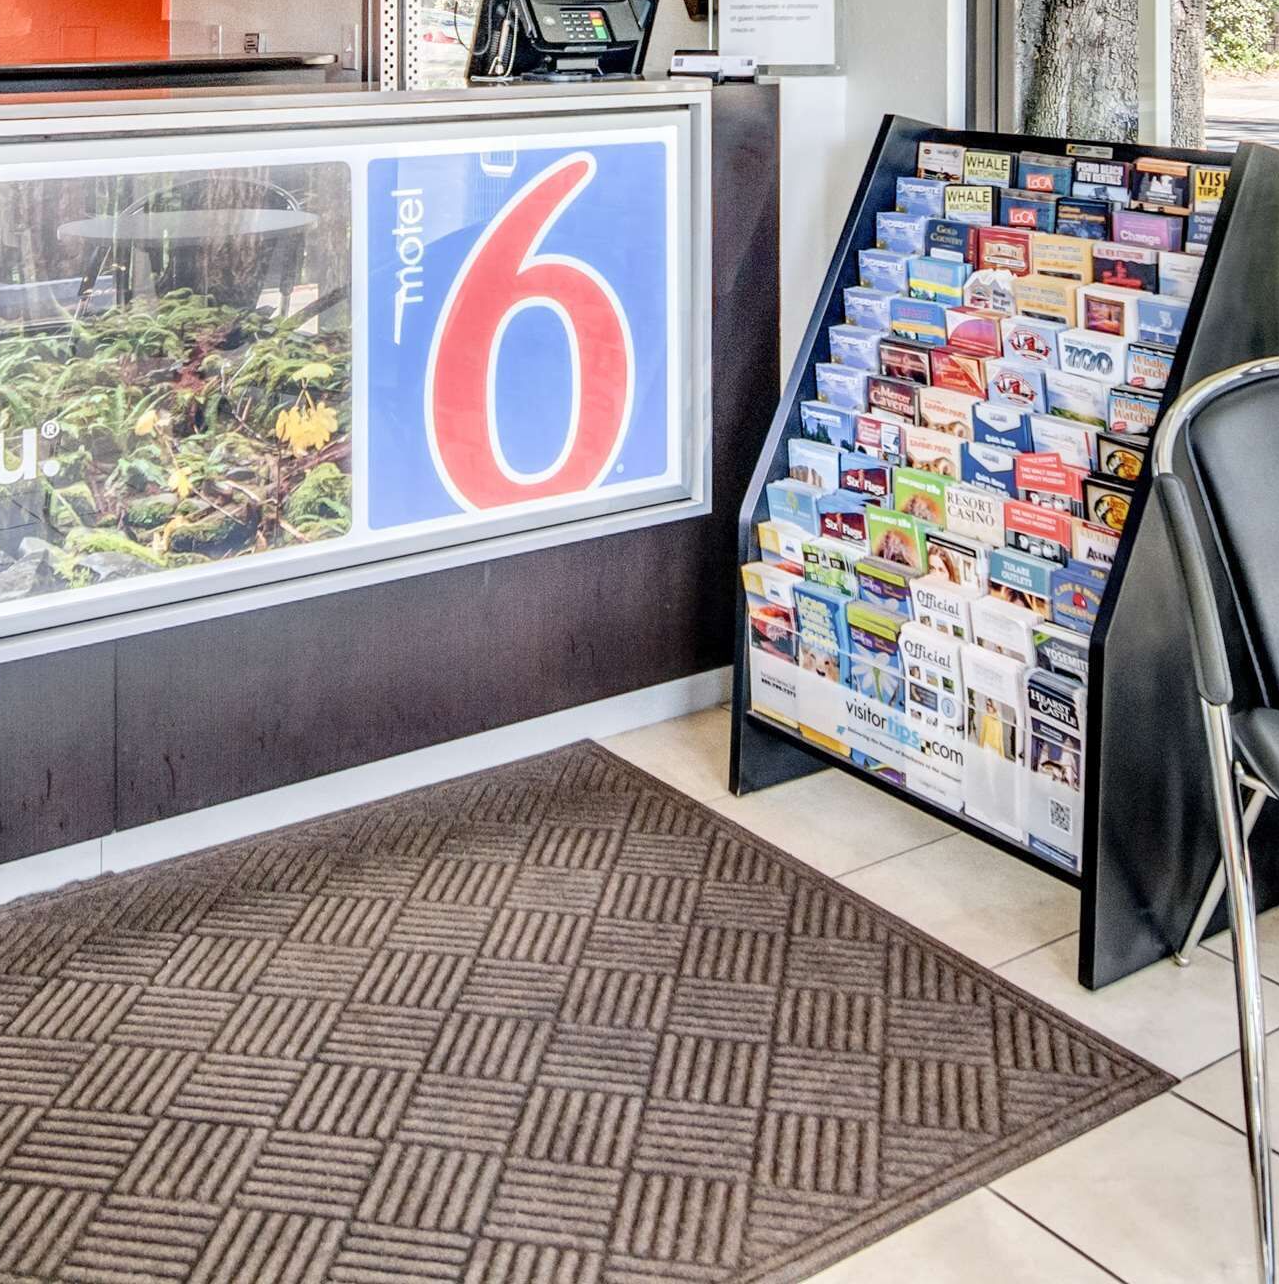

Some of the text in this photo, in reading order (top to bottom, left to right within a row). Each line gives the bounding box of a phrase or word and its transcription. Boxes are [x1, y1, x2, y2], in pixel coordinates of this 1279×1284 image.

[966, 156, 1009, 171] WHALE
[968, 168, 1006, 179] WATCHING
[947, 190, 990, 204] WHALE
[1198, 187, 1218, 197] TIPS
[949, 202, 988, 212] WATCHING
[1120, 230, 1161, 246] Change
[390, 150, 636, 514] motel 6
[1064, 345, 1113, 375] ZOO
[870, 390, 914, 416] Caverns
[881, 386, 912, 403] Mercer
[847, 476, 886, 496] Six Flags
[947, 491, 994, 514] RESORT
[948, 504, 995, 527] CASINO
[825, 517, 863, 540] Six Flags
[1001, 570, 1032, 587] OUTLETS
[1003, 561, 1030, 576] TULARE
[916, 589, 960, 616] Official
[904, 640, 951, 669] Official
[1030, 688, 1071, 714] HEARST
[1038, 700, 1078, 726] CASTLE
